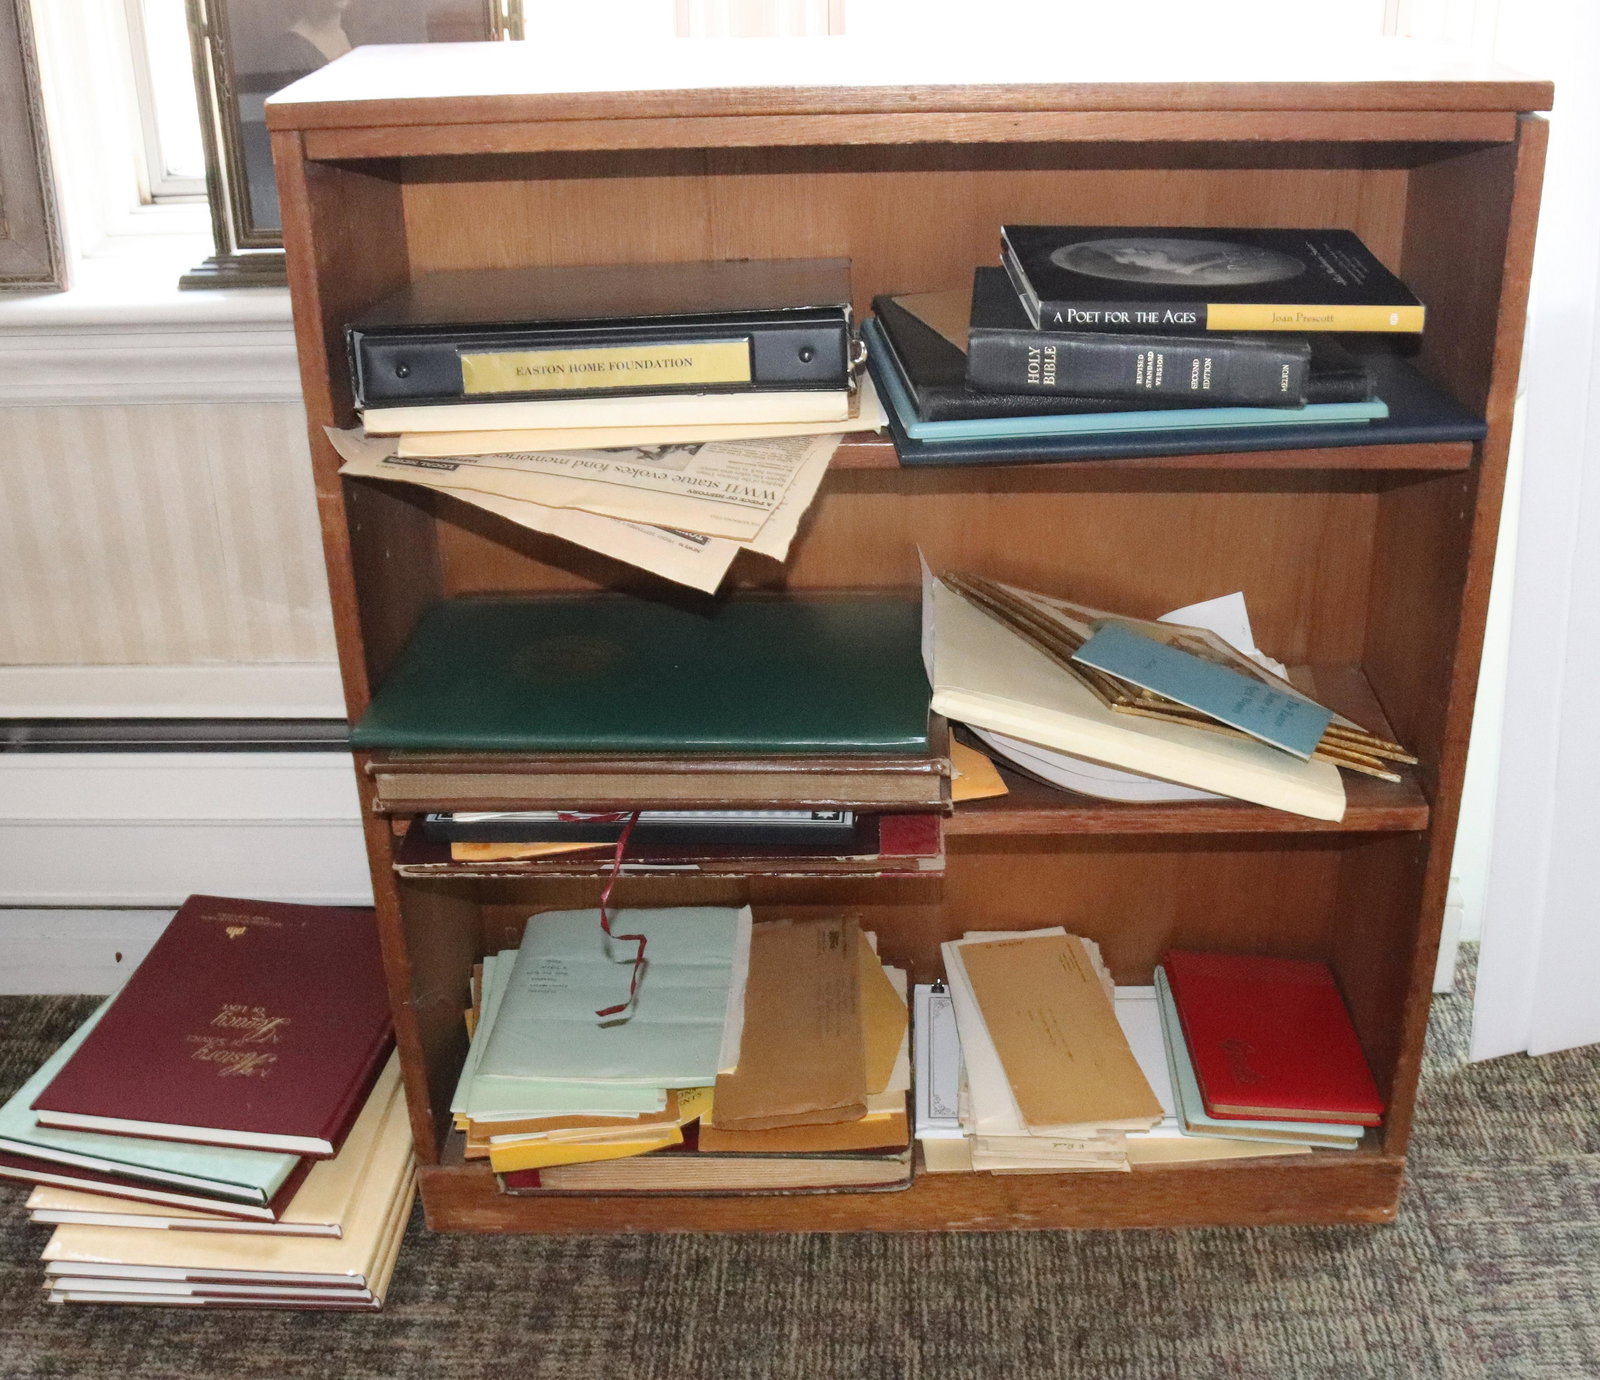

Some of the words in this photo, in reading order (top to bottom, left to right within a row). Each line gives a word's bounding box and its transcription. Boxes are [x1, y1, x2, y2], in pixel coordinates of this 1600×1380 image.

[1053, 311, 1063, 323] A
[1067, 309, 1101, 323] POET
[1104, 311, 1130, 323] FOR
[1135, 311, 1159, 323] THE
[1162, 309, 1197, 324] AGES
[1271, 312, 1293, 324] Joan
[1295, 312, 1334, 323] Prescott
[516, 364, 565, 376] EASTON
[569, 362, 605, 374] HOME
[609, 358, 693, 371] FOUNDATION
[1027, 346, 1040, 385] HOLY
[1043, 345, 1056, 386] BIBLE
[1136, 354, 1145, 385] REVISED
[1145, 351, 1154, 388] STANDARD
[1155, 353, 1164, 386] VERSION
[1191, 358, 1200, 390] SECOND
[1202, 357, 1212, 390] EDITION
[421, 460, 454, 470] LOCAL
[571, 455, 610, 474] fond
[615, 465, 668, 480] evokes
[671, 474, 720, 489] statue
[725, 484, 776, 500] WWII
